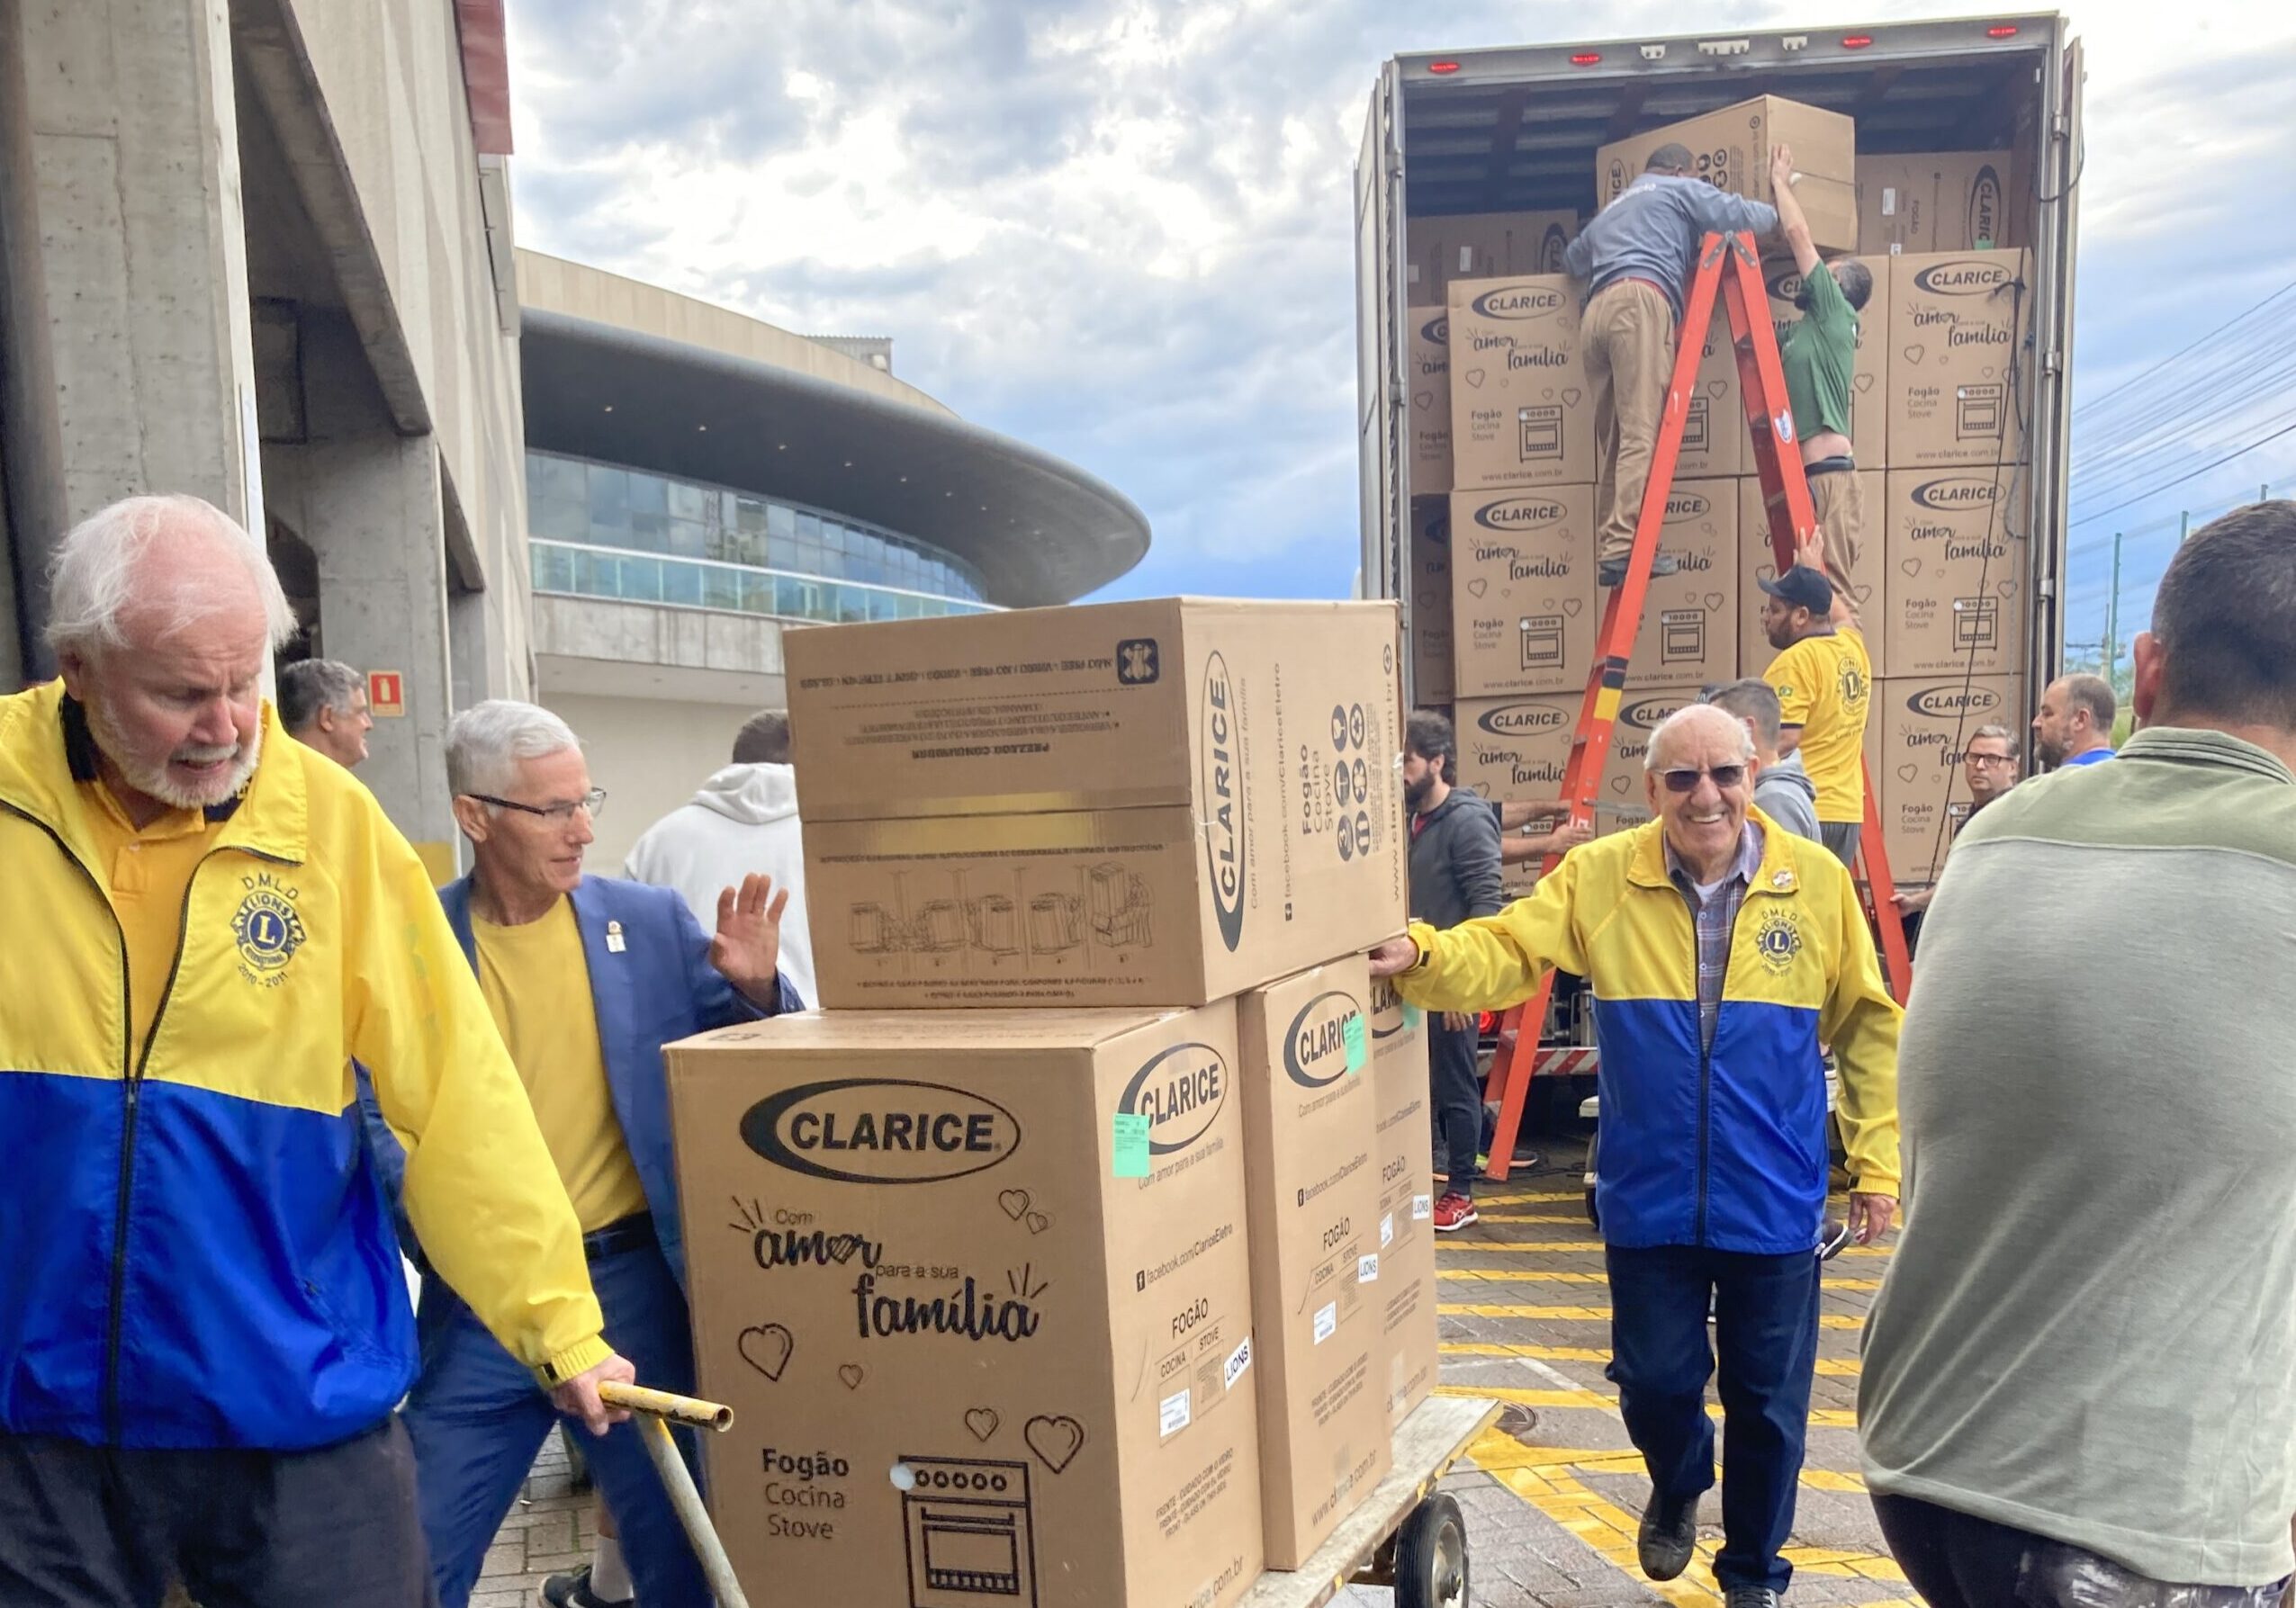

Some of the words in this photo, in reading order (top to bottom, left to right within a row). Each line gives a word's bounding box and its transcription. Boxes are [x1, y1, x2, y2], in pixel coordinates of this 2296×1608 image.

[1978, 182, 1993, 241] CLARIC
[1931, 270, 2003, 286] CLARICE
[1488, 294, 1557, 311] CLARICE
[1914, 310, 1959, 327] amor
[1473, 333, 1517, 352] amor
[1908, 387, 1940, 400] Fogão
[1471, 409, 1502, 422] Fogão
[1929, 488, 1995, 501] CLARICE
[1491, 506, 1559, 521] CLARICE
[1665, 499, 1703, 514] RICE
[1912, 526, 1956, 541] amor
[1476, 546, 1519, 561] amor
[1905, 598, 1937, 610] Fogão
[1473, 618, 1504, 630] Fogão
[1923, 694, 1993, 709] CLARICE
[1494, 712, 1562, 728] CLARICE
[1906, 732, 1951, 748] amor
[1479, 751, 1522, 766] amor
[1209, 678, 1235, 897] CLARICE
[1300, 744, 1311, 835] Fogão
[1311, 750, 1322, 833] Cocina
[1322, 763, 1334, 831] Stove
[1245, 786, 1254, 822] para
[1902, 804, 1933, 816] Fogão
[1247, 828, 1256, 868] amor
[1250, 873, 1258, 909] Com
[252, 894, 291, 916] LIONS
[257, 915, 275, 944] L
[1773, 932, 1785, 950] L
[1140, 1063, 1220, 1129] CLARICE
[790, 1112, 995, 1151] CLARICE
[1382, 1155, 1406, 1185] FOGÃO
[1414, 1199, 1428, 1214] LIONS
[776, 1208, 815, 1226] Com
[1323, 1217, 1350, 1251] FOGÃO
[754, 1228, 882, 1270] amor
[876, 1265, 912, 1280] para
[915, 1268, 926, 1278] a
[931, 1266, 959, 1279] sua
[1360, 1260, 1376, 1276] LIONS
[851, 1272, 1040, 1342] família
[1172, 1297, 1209, 1340] FOGÃO
[1199, 1326, 1220, 1351] STOVE
[1160, 1351, 1187, 1378] COCINA
[1226, 1345, 1249, 1381] LIONS
[761, 1447, 850, 1481] Fogão
[765, 1482, 845, 1510] Cocina
[767, 1514, 834, 1541] Stove
